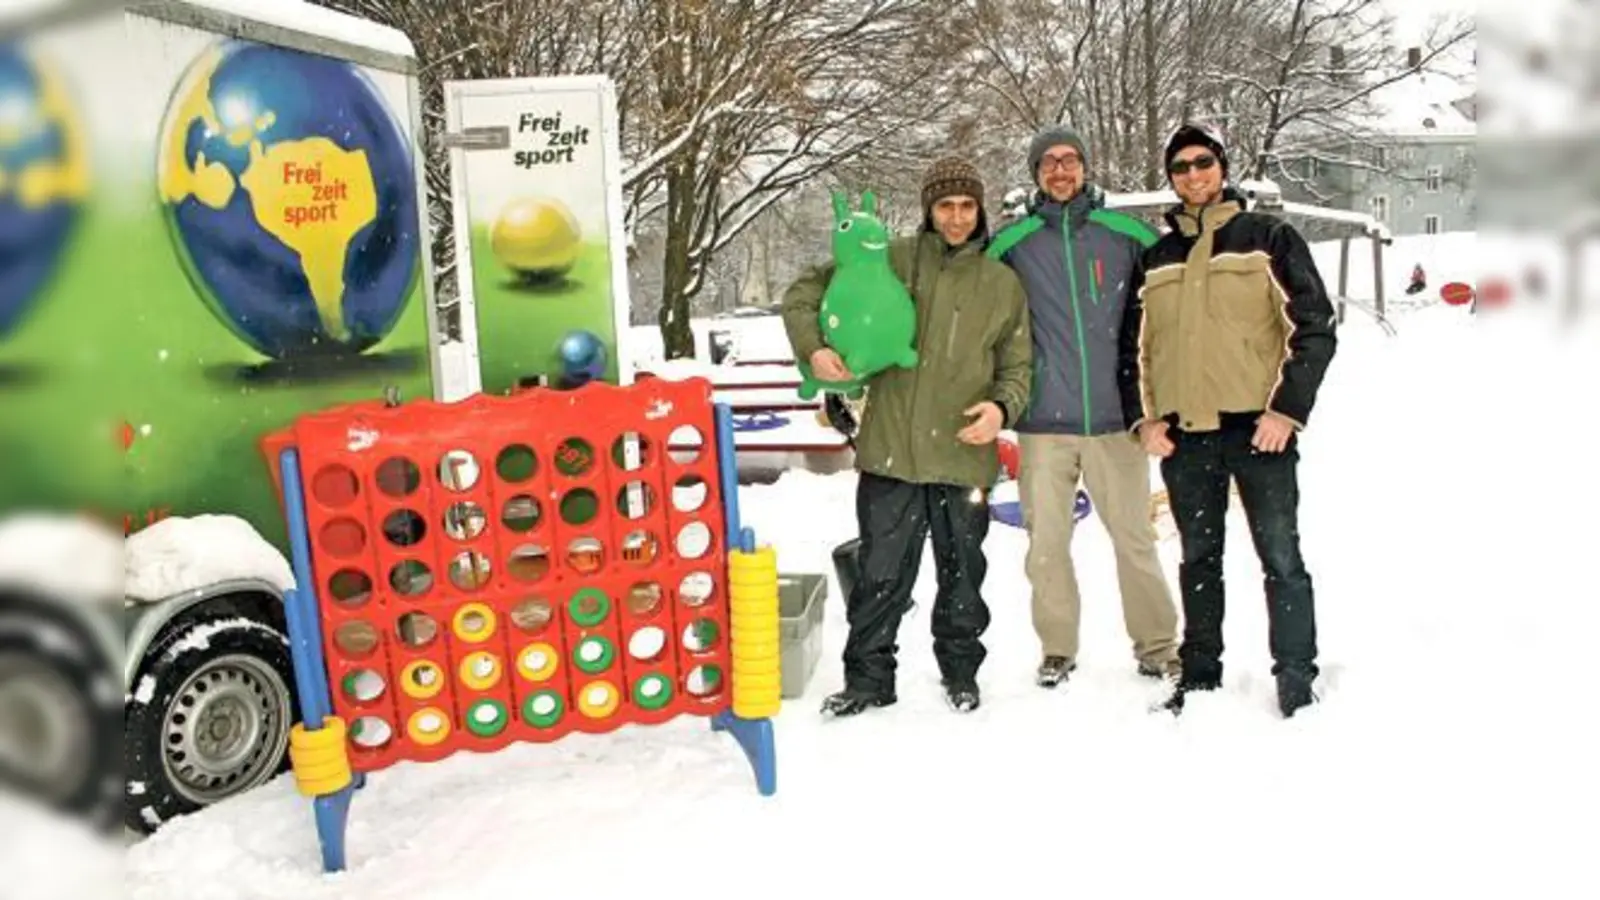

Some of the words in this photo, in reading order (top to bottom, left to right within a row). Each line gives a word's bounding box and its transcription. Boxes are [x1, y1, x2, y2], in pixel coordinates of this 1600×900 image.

[518, 110, 562, 133] Frei
[547, 125, 589, 146] zeit
[514, 147, 574, 170] sport
[283, 162, 321, 185] Frei
[312, 178, 347, 201] zeit
[283, 202, 338, 229] sport
